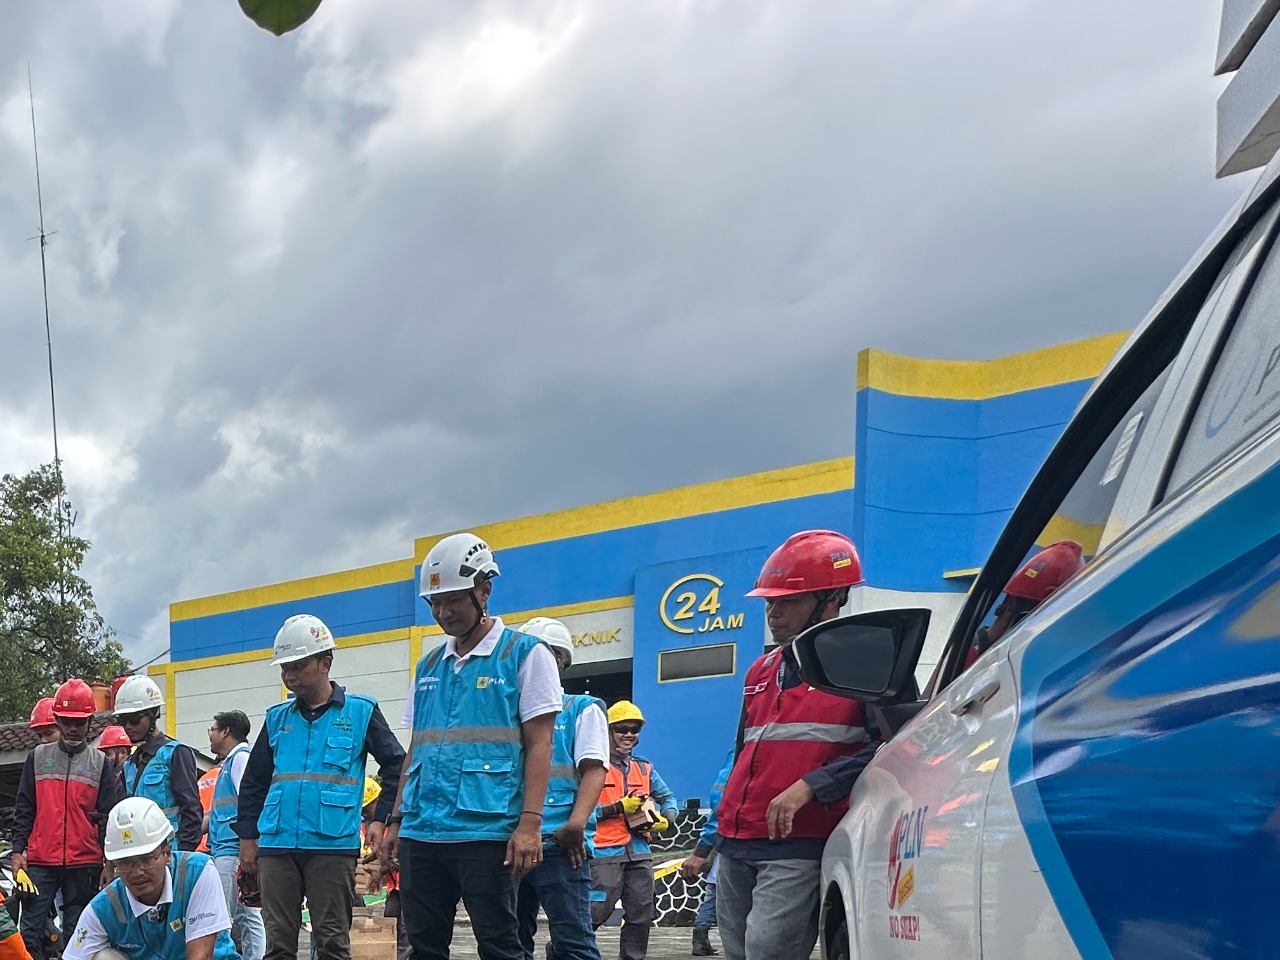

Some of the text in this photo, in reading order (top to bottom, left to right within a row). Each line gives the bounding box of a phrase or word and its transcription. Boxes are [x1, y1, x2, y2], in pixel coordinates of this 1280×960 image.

[673, 587, 721, 621] 24
[697, 613, 745, 633] JAM
[572, 627, 621, 648] EKNIK
[488, 677, 506, 685] PLN
[897, 805, 928, 860] PLN
[889, 915, 921, 941] NO SUAP!
